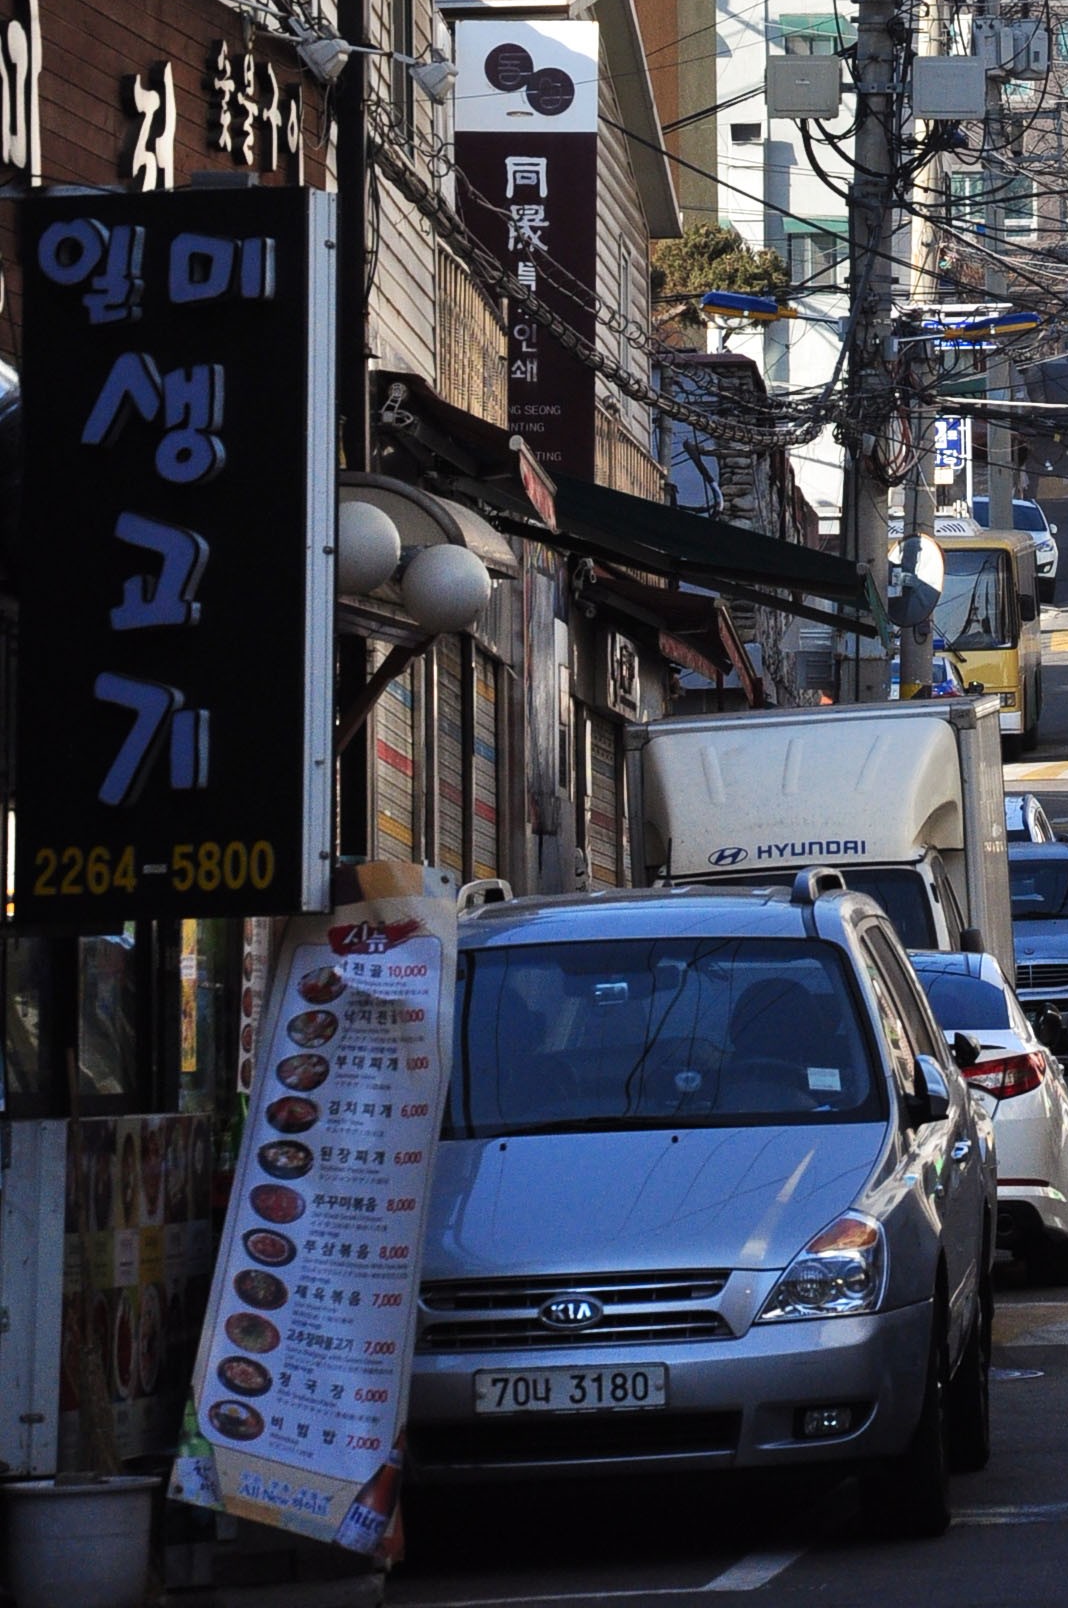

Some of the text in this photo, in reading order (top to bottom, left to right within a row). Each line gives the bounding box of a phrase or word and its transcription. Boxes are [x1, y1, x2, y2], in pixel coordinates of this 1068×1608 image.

[37, 218, 276, 325] 일미
[524, 404, 561, 416] SEONG
[757, 840, 866, 859] HYUNDAI
[34, 839, 276, 898] 2264-5800
[387, 964, 427, 978] 10,000
[334, 1054, 399, 1071] 부대찌개
[328, 1100, 429, 1119] 김치찌개 6,000
[320, 1146, 423, 1167] 된장찌개 6,000
[385, 1198, 416, 1213] 8,000
[379, 1245, 410, 1260] 8,000
[294, 1284, 403, 1308] 제육볶음 7,000
[550, 1302, 592, 1320] KIA
[362, 1340, 397, 1356] 7,000
[278, 1371, 388, 1404] 청국장 6,000
[491, 1371, 649, 1408] 70나 3180
[270, 1415, 337, 1446] 비빔밥
[345, 1434, 381, 1452] 7,000
